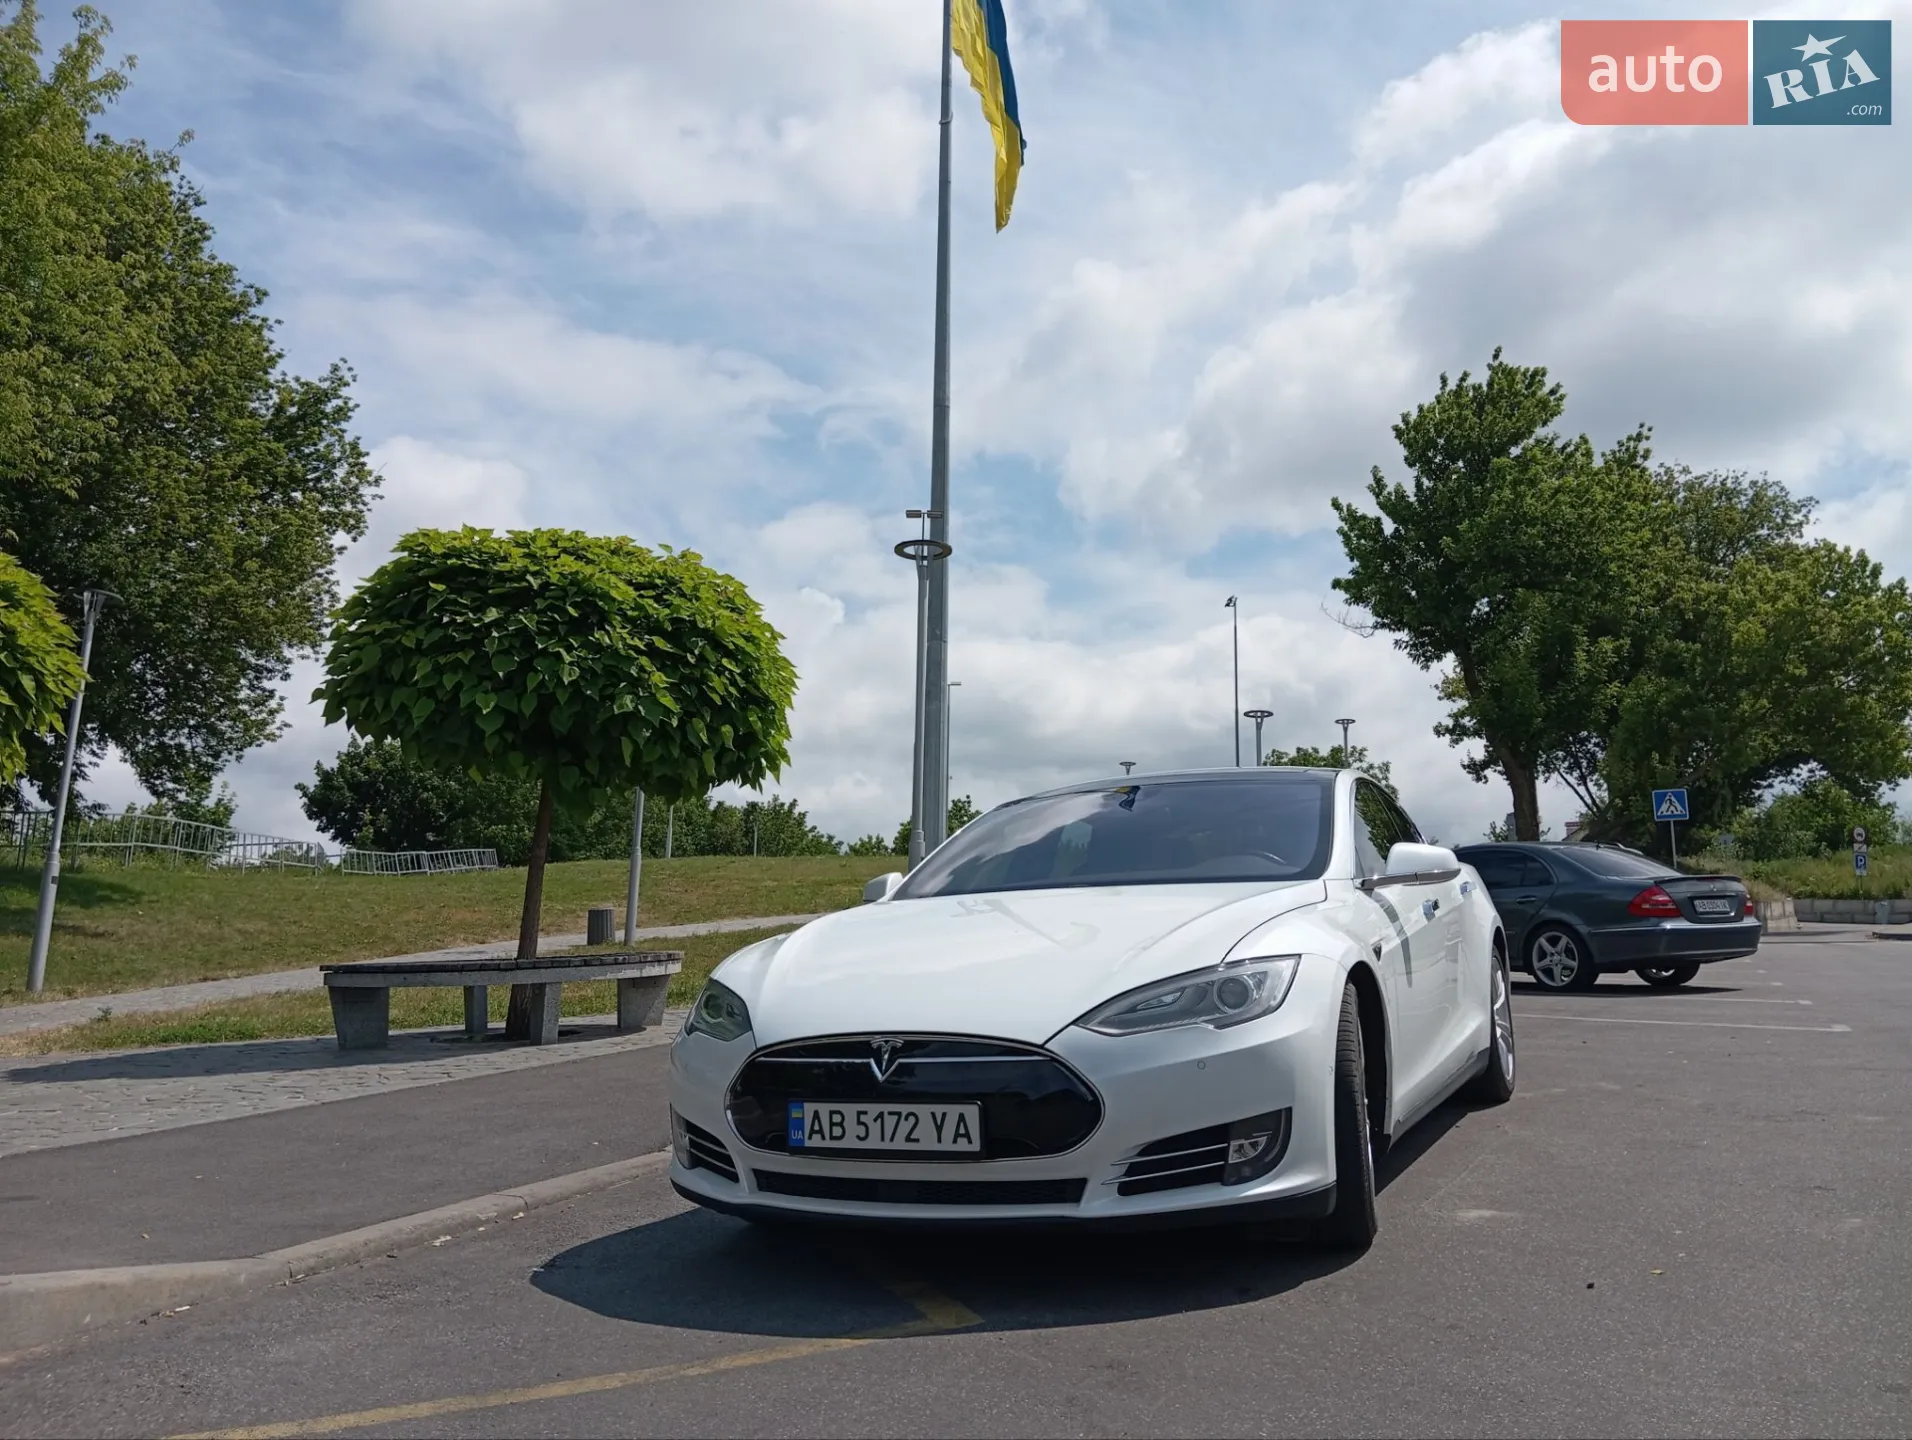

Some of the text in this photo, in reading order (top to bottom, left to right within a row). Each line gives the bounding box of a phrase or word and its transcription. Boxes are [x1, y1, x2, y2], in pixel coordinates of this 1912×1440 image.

[1857, 856, 1865, 867] P
[807, 1109, 974, 1145] AB 5172 YA
[791, 1129, 804, 1140] UA
